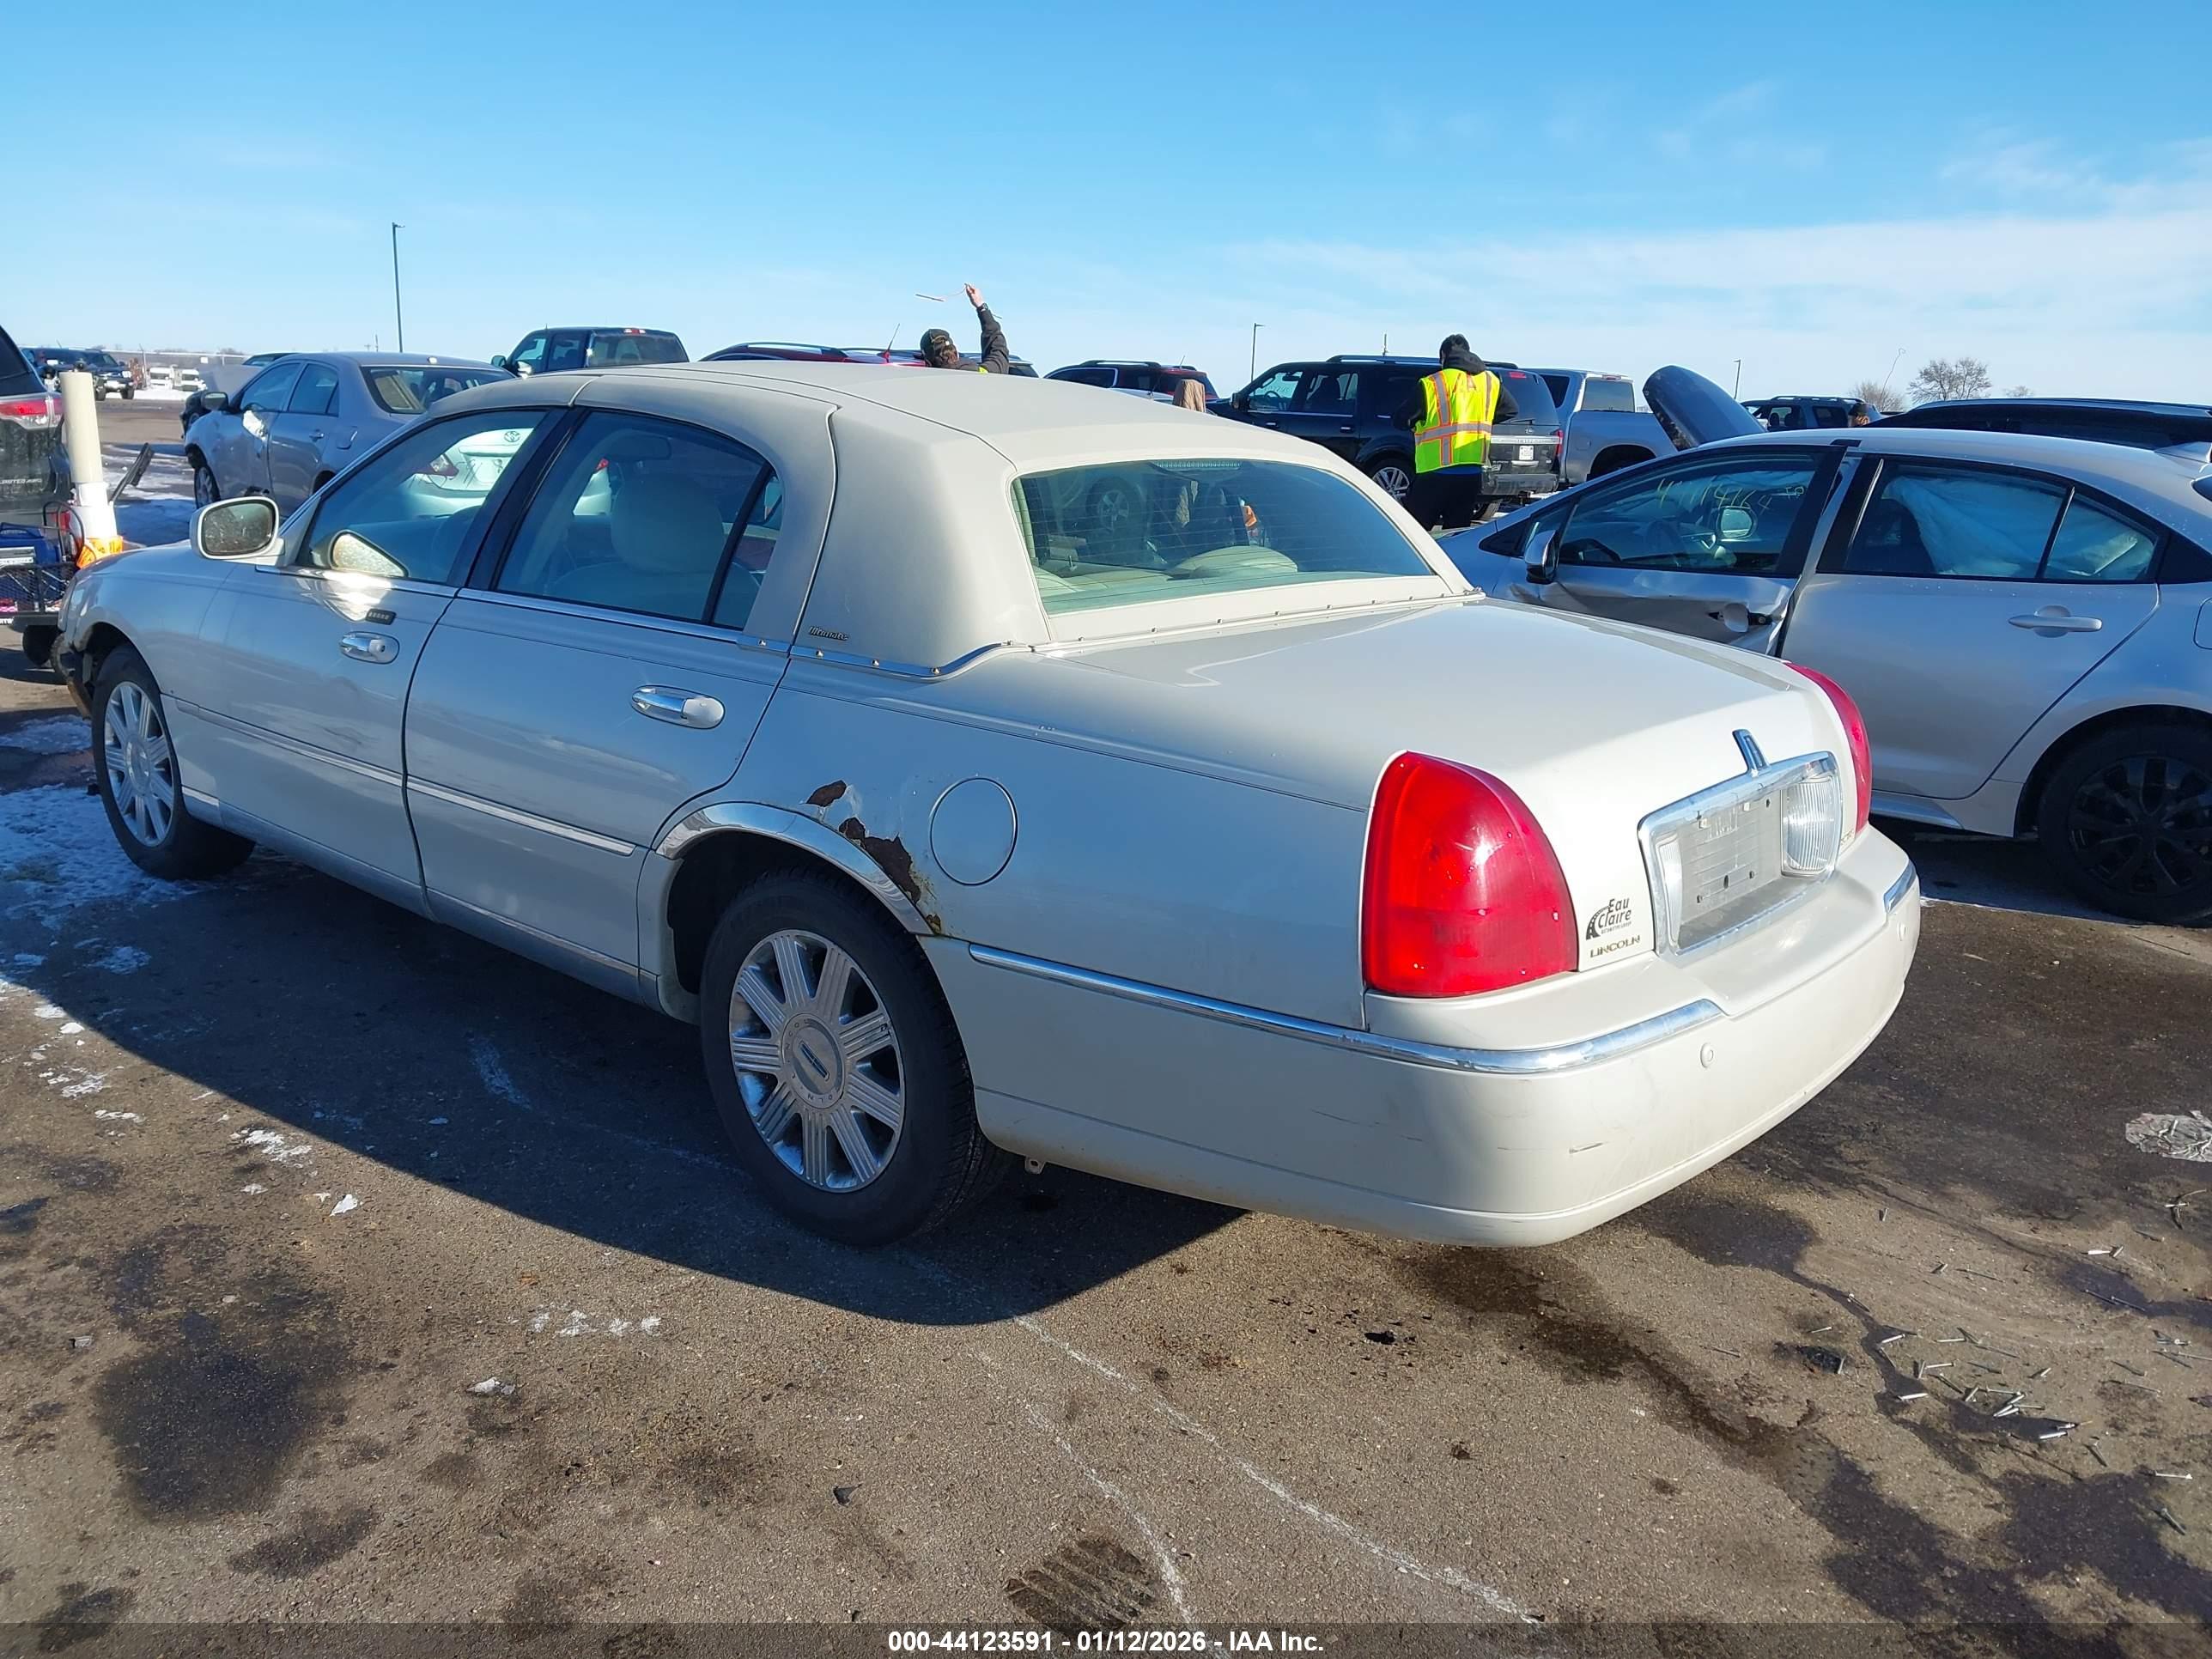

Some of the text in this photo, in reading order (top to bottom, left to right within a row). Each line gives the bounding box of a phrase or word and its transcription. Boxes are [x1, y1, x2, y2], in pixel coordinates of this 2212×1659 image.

[1607, 898, 1630, 913] Eau
[1598, 910, 1632, 929] Claire
[1590, 935, 1640, 957] LINCOLN
